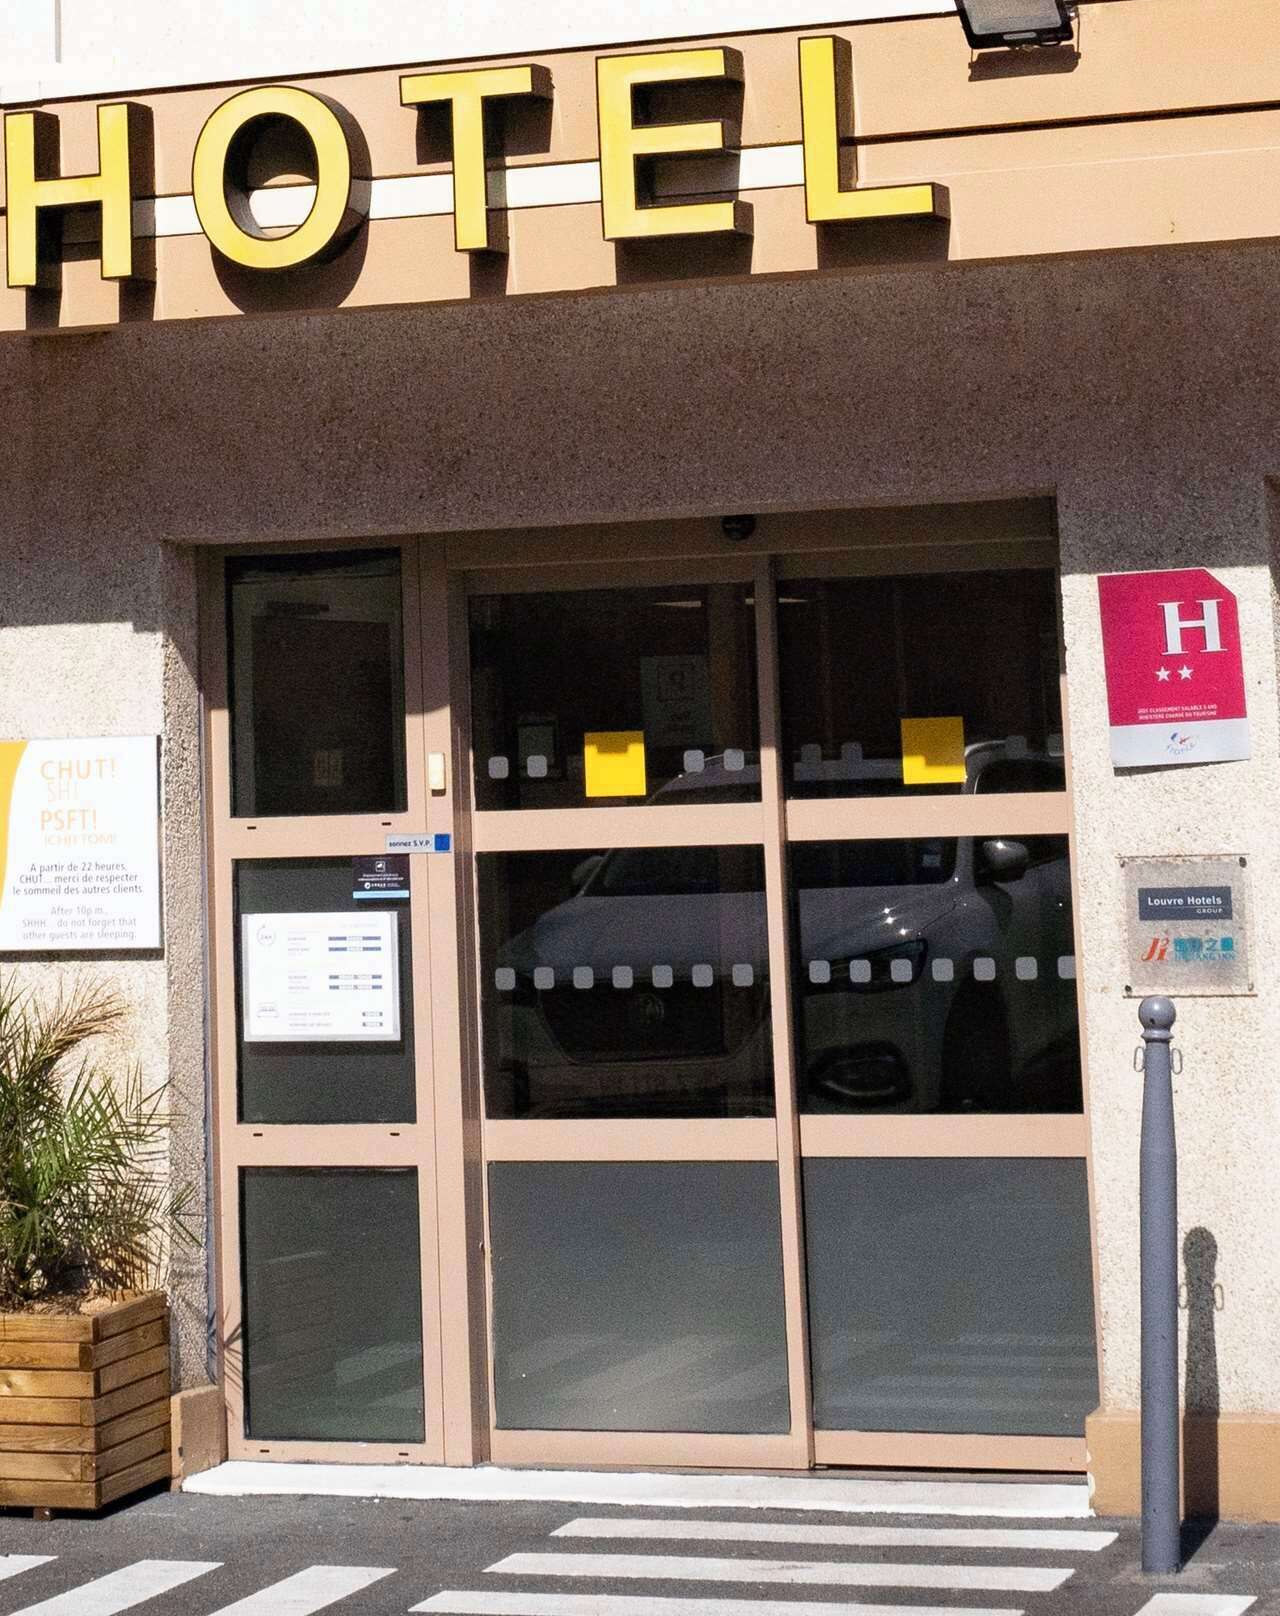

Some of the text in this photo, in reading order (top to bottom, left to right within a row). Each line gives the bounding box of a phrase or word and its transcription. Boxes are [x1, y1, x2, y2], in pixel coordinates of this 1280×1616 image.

[4, 35, 944, 290] HOTEL
[1158, 598, 1228, 655] H
[40, 758, 118, 781] CHUT!
[388, 840, 412, 848] sonnez
[39, 863, 65, 875] partir
[67, 862, 79, 872] de
[81, 862, 93, 872] 22
[54, 873, 80, 883] merci
[82, 872, 94, 882] de
[95, 872, 139, 884] respecter
[12, 885, 21, 895] le
[23, 885, 61, 895] sommeil
[63, 884, 80, 895] des
[82, 885, 111, 895] autres
[1147, 895, 1223, 906] Louvre Hotels
